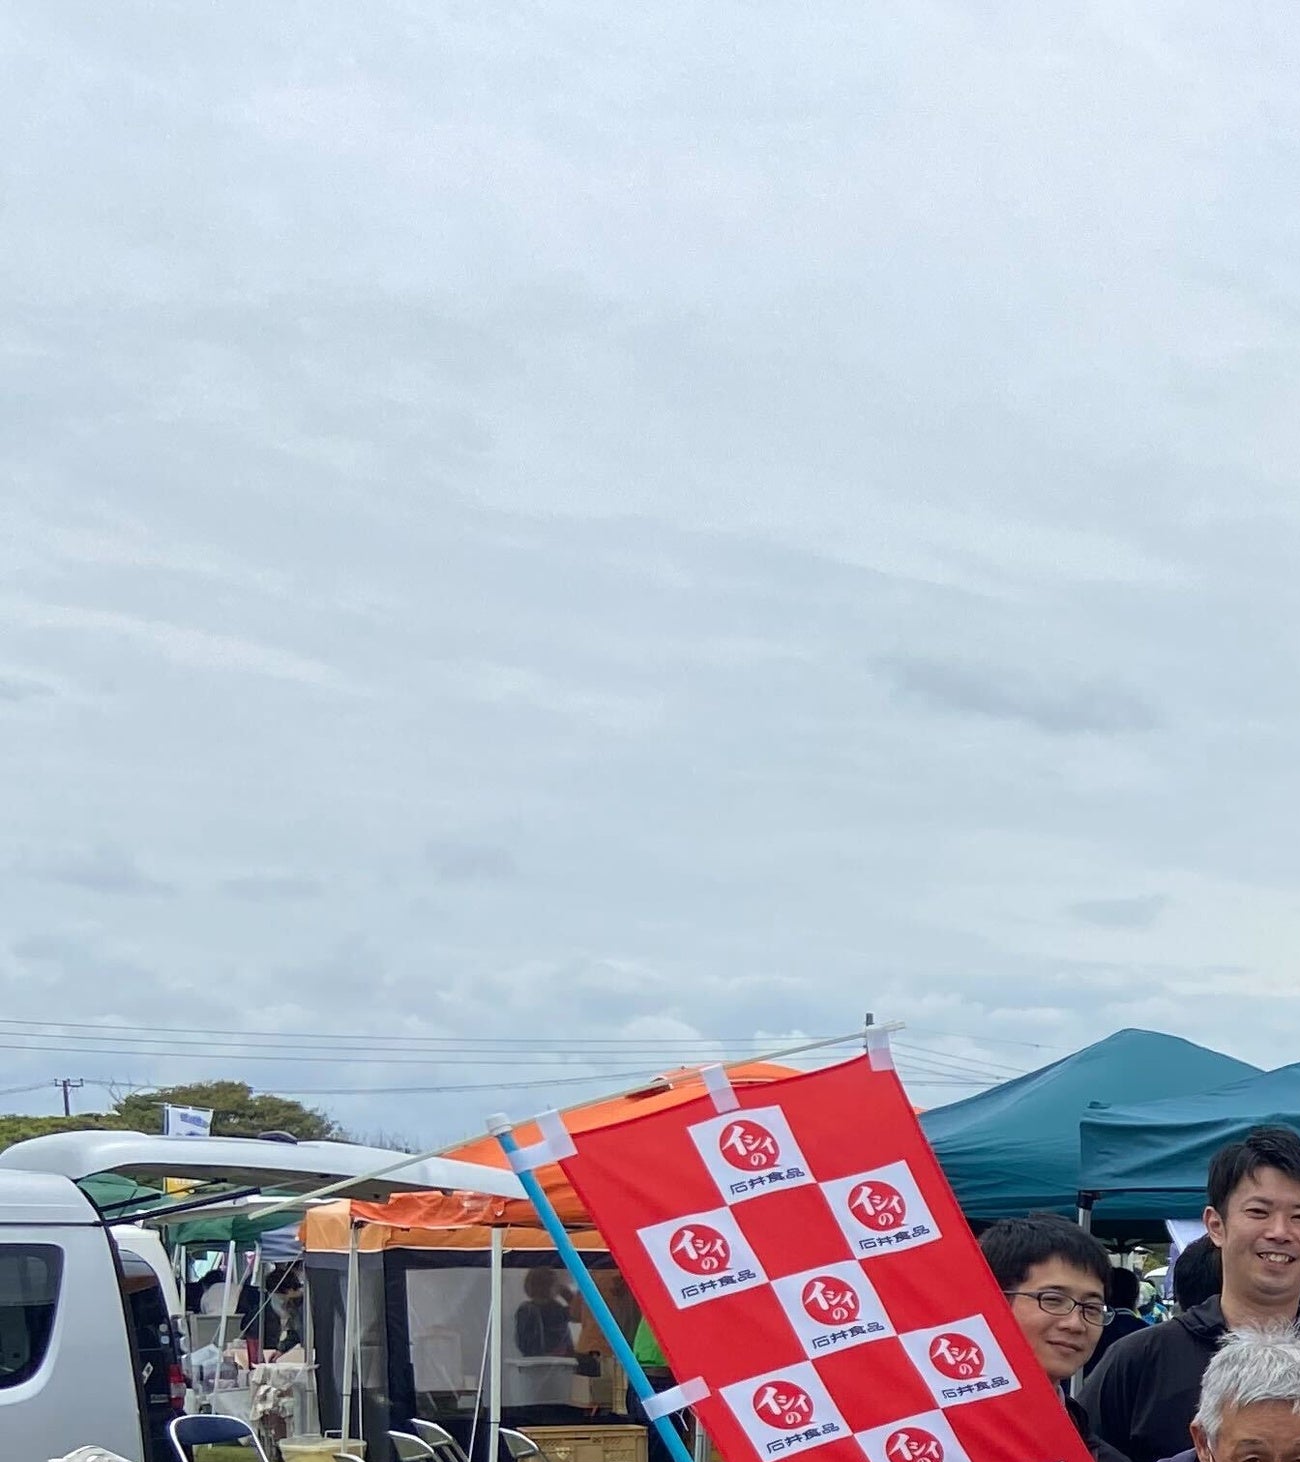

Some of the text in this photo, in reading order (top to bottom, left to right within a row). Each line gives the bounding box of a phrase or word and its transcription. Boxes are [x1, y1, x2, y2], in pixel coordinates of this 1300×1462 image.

[730, 1167, 804, 1194] 石井食品
[859, 1225, 930, 1250] 石井食品
[680, 1268, 756, 1298] 石井食品
[811, 1321, 885, 1348] 石井食品
[942, 1374, 1009, 1399] 石井食品
[767, 1421, 840, 1451] 石井食品
